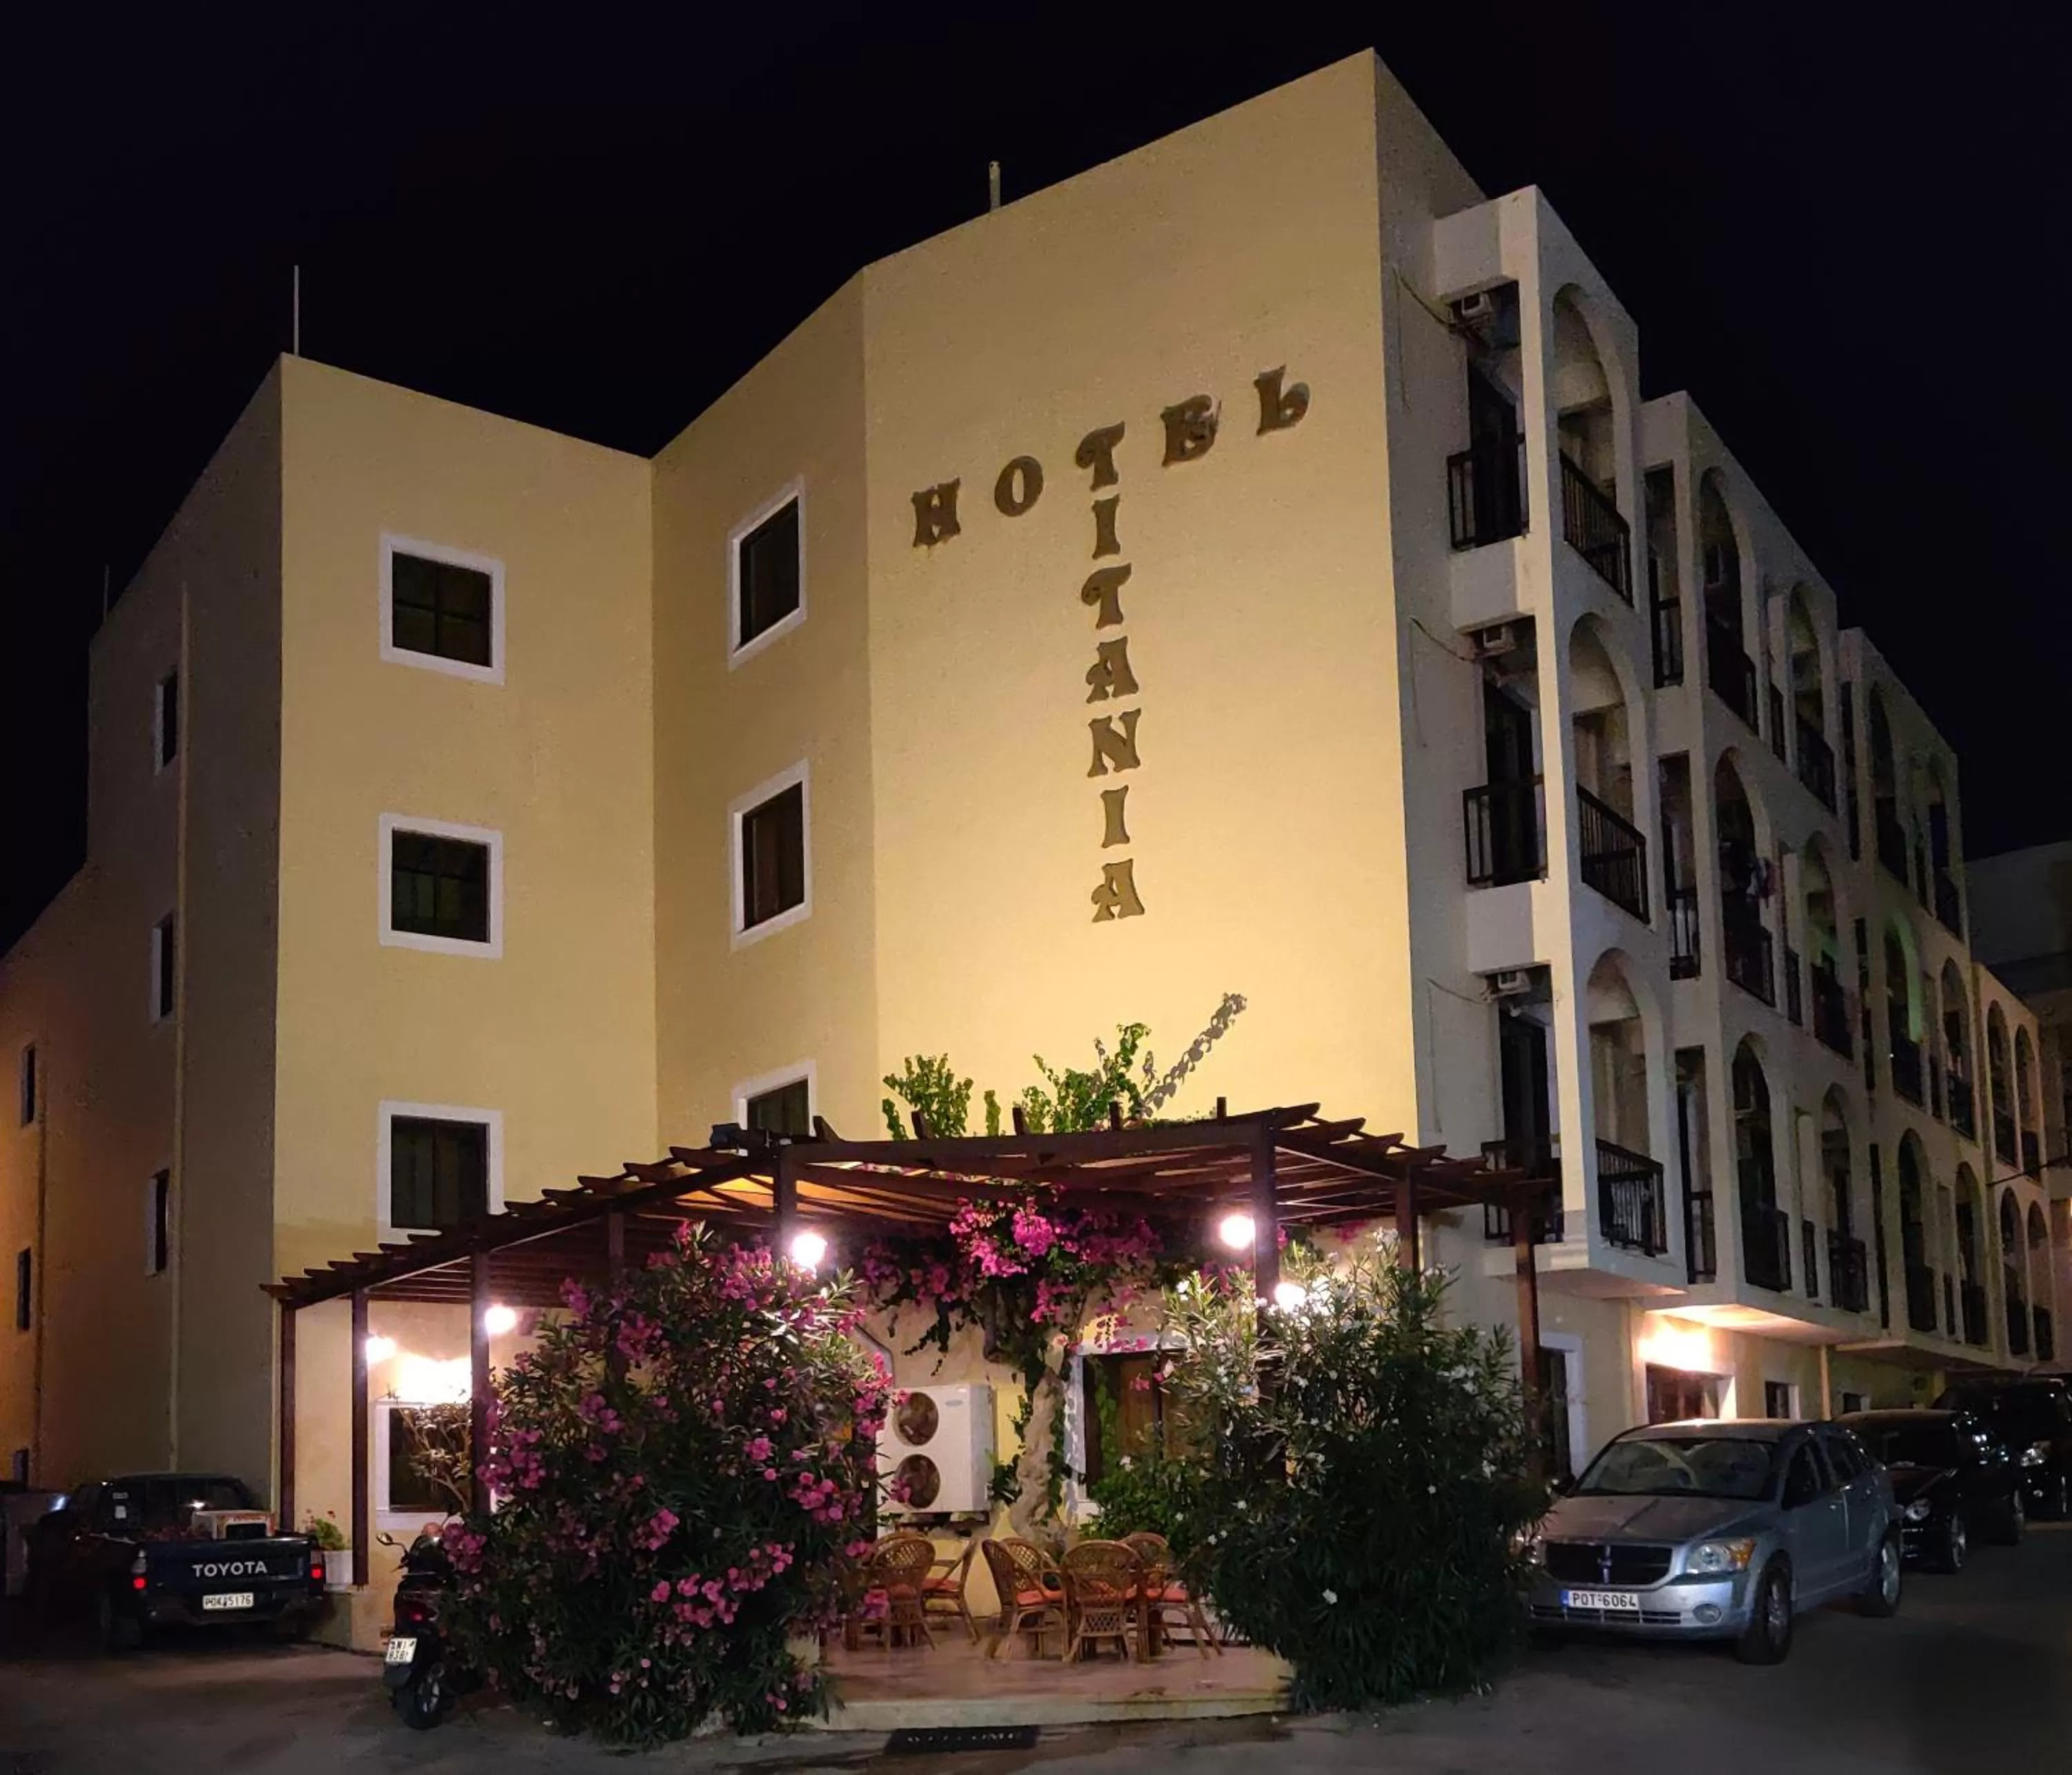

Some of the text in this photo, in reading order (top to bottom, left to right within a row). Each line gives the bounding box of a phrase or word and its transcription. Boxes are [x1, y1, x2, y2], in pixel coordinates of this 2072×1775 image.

[911, 365, 1311, 548] HOTEL
[1075, 421, 1145, 923] TITANIA
[191, 1561, 268, 1577] TOYOTA
